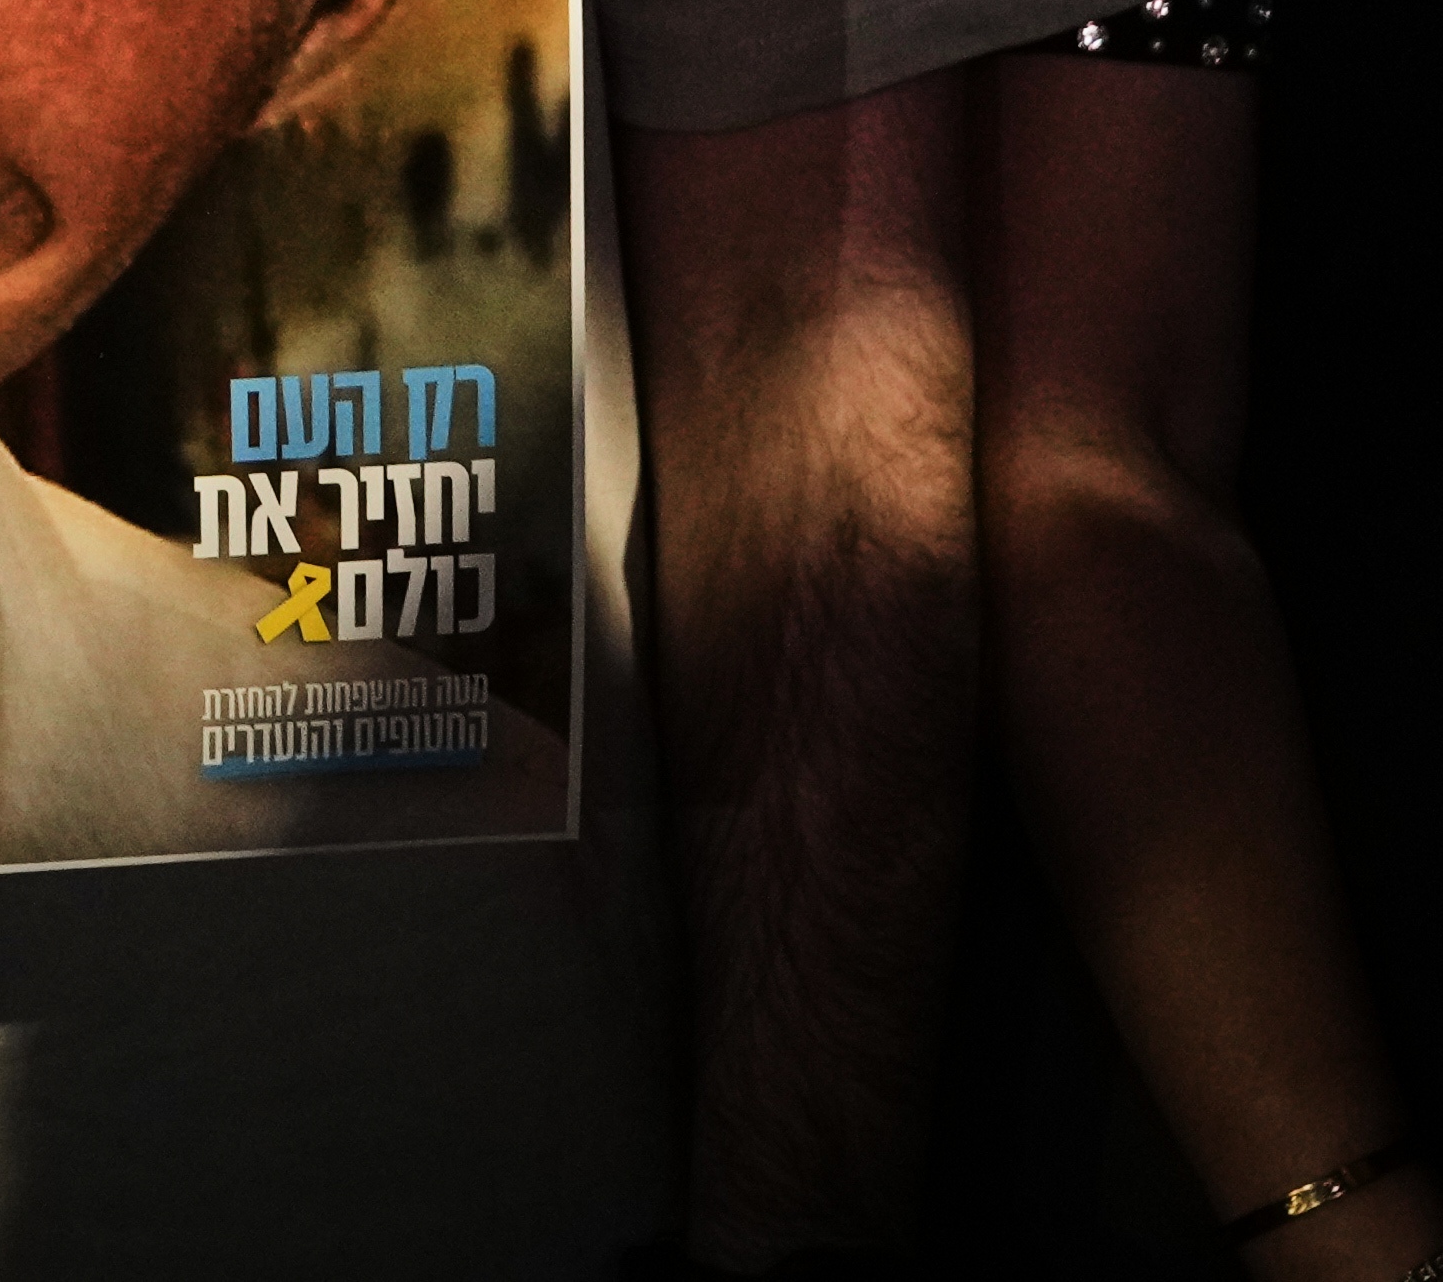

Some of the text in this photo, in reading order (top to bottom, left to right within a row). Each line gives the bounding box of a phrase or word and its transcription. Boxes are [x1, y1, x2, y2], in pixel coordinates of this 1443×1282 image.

[230, 364, 496, 463] רק העם
[192, 458, 496, 558] יחזיר את
[337, 548, 496, 641] כולם
[202, 673, 489, 720] מטה המשפחות להחזרת
[202, 710, 488, 766] החטופים והנעדרים
